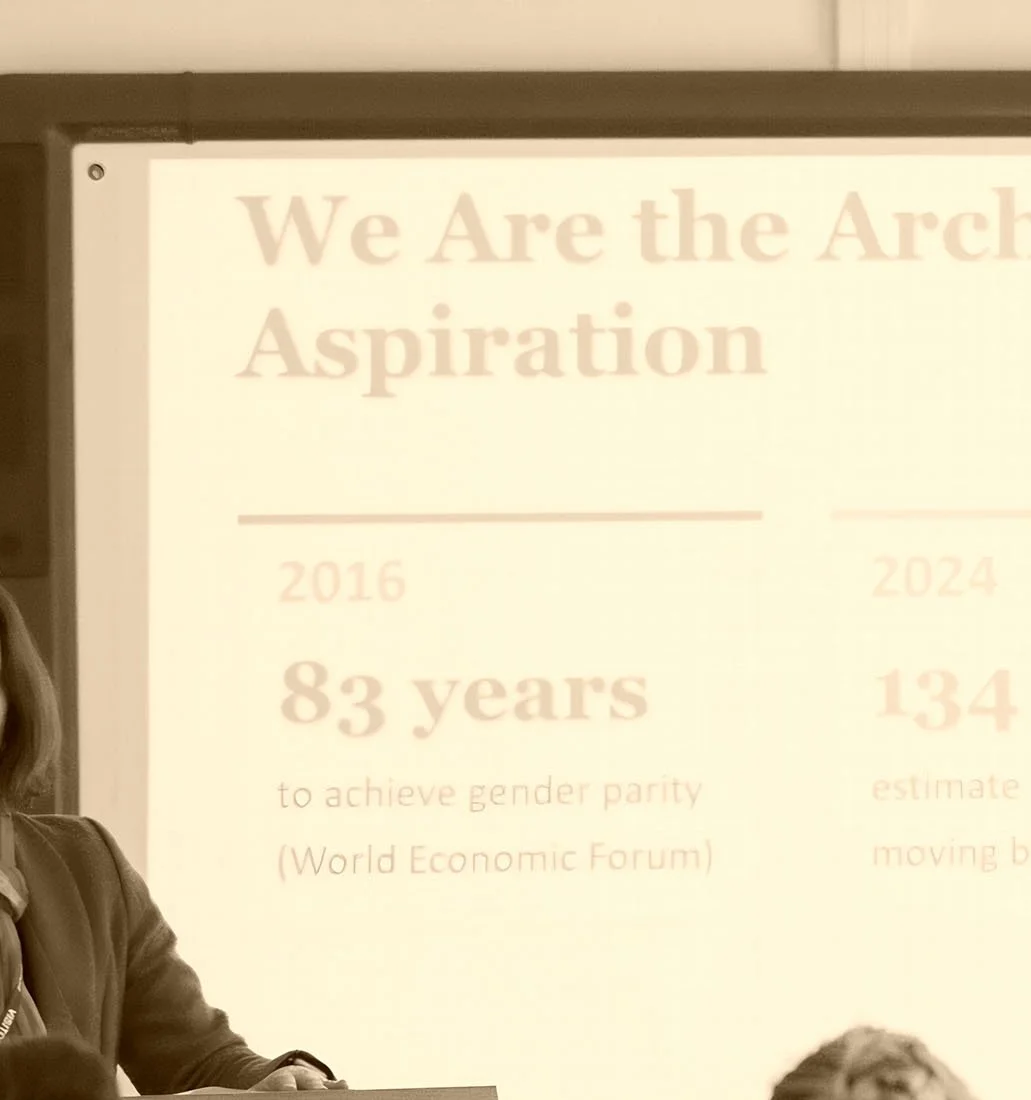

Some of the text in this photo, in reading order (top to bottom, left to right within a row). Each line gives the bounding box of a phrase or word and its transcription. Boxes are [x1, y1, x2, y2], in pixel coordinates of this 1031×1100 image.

[235, 196, 400, 267] We
[425, 192, 605, 265] Are
[632, 188, 789, 265] the
[235, 301, 767, 398] Aspiration
[278, 559, 406, 604] 2016
[872, 554, 998, 598] 2024
[280, 660, 648, 740] 83 years
[875, 668, 1019, 733] 134
[277, 775, 703, 813] to achieve gender parity
[872, 773, 1020, 801] estimate
[277, 839, 713, 882] (World Economic Forum)
[873, 838, 998, 873] moving
